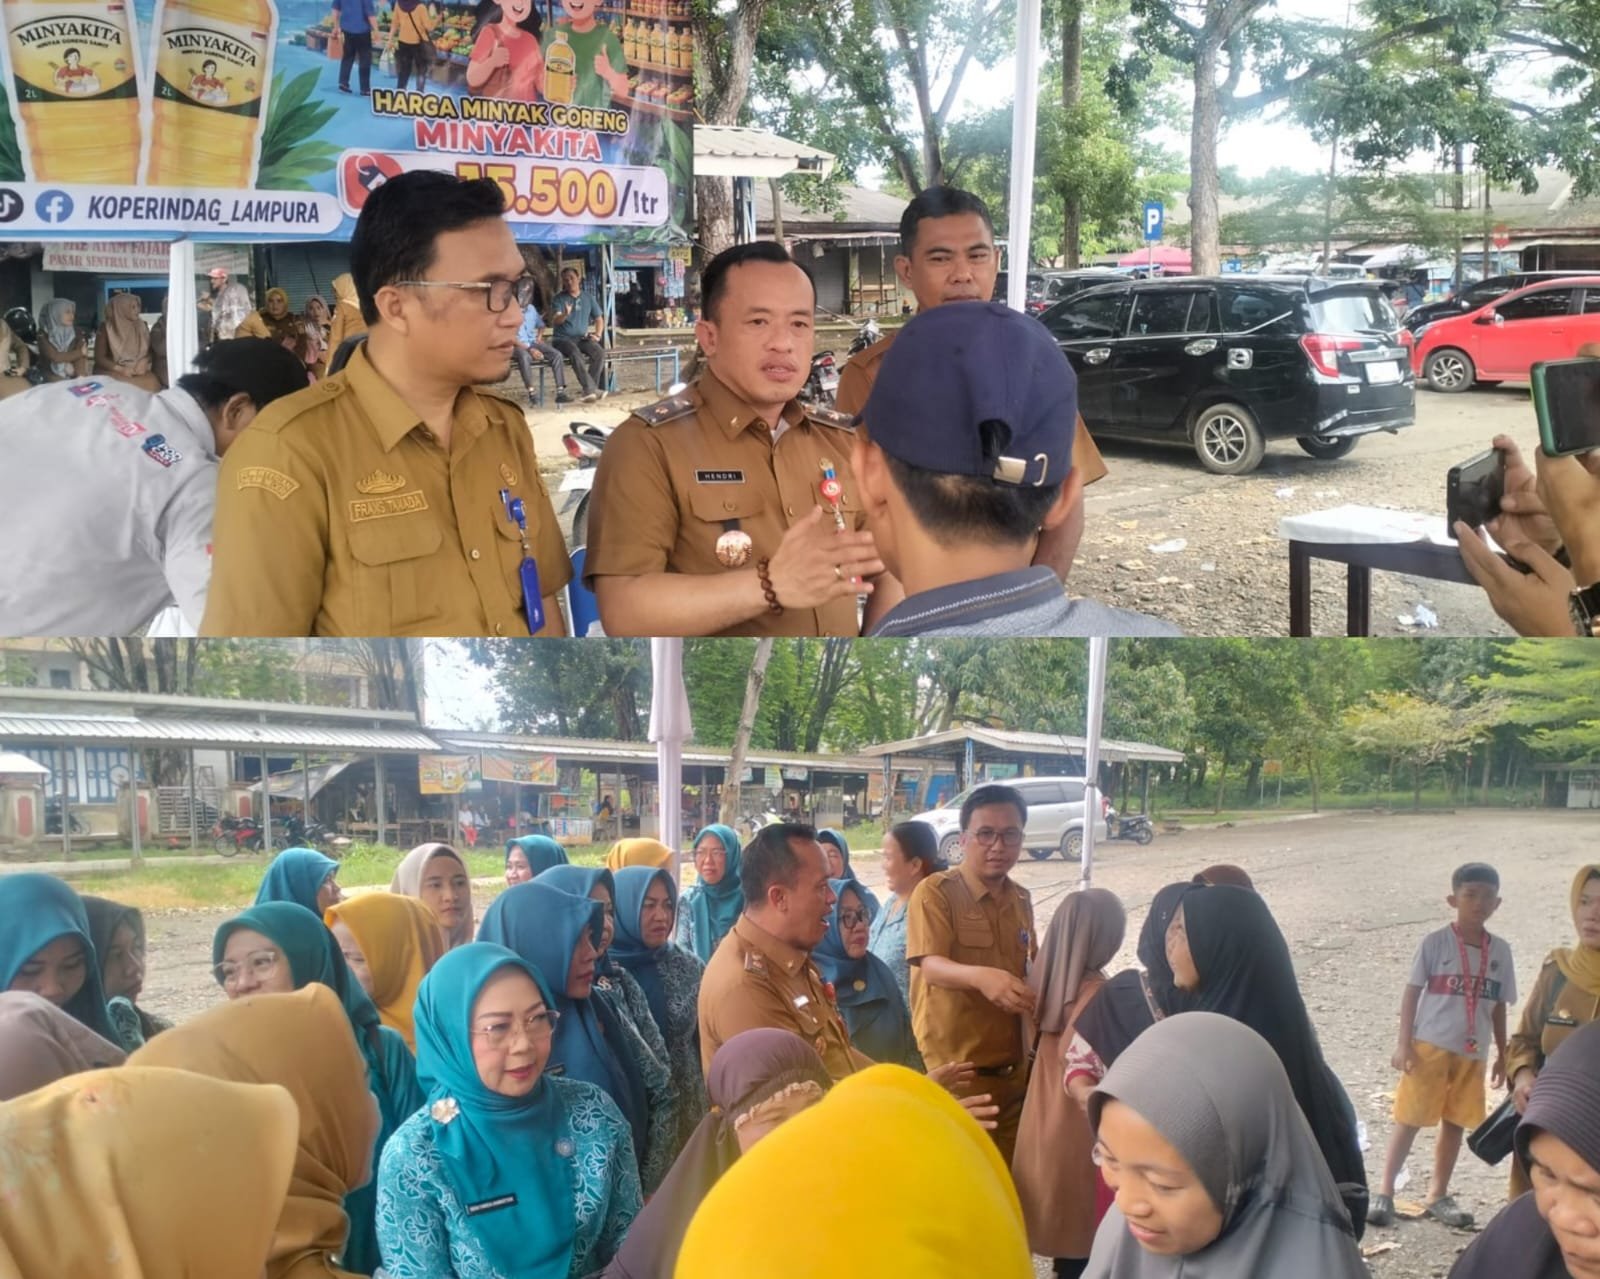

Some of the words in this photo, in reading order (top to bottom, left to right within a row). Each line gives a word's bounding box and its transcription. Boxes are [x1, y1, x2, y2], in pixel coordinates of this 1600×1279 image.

[17, 22, 122, 46] MINYAKITA
[166, 33, 257, 68] MINYAKITA
[372, 89, 455, 119] HARGA
[463, 99, 547, 124] MINYAK
[551, 108, 629, 133] GORENG
[415, 120, 602, 160] MINYAKITA
[88, 195, 320, 226] KOPERINDAG_LAMPURA
[1147, 208, 1160, 234] P
[49, 254, 82, 267] PASAR
[86, 255, 128, 269] SENTRAL
[704, 472, 736, 480] HENDRI
